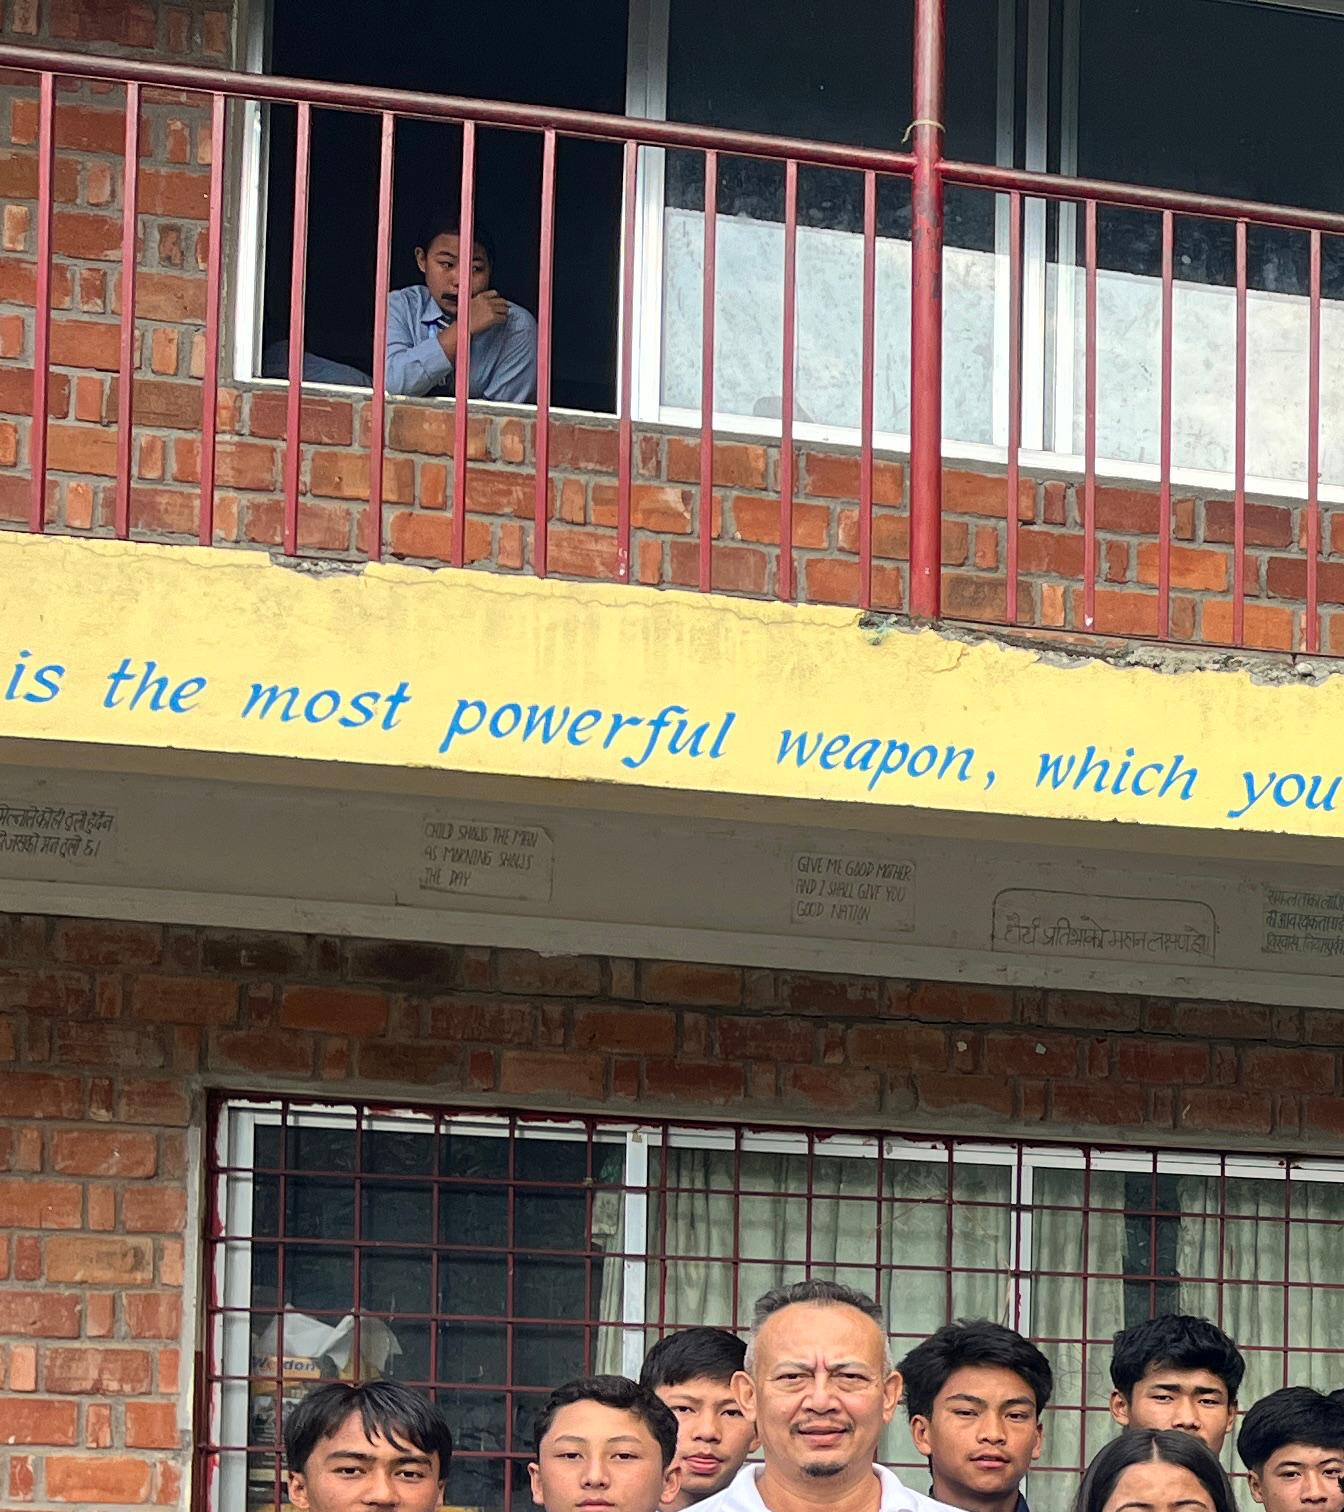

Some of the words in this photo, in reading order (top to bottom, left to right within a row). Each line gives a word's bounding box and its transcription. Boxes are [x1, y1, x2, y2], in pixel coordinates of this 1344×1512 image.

[5, 649, 66, 703] is
[103, 658, 208, 713] the
[241, 681, 411, 730] most
[438, 698, 736, 769] powerful
[776, 727, 996, 791] weapon,
[1036, 745, 1200, 800] which
[1227, 770, 1342, 819] you
